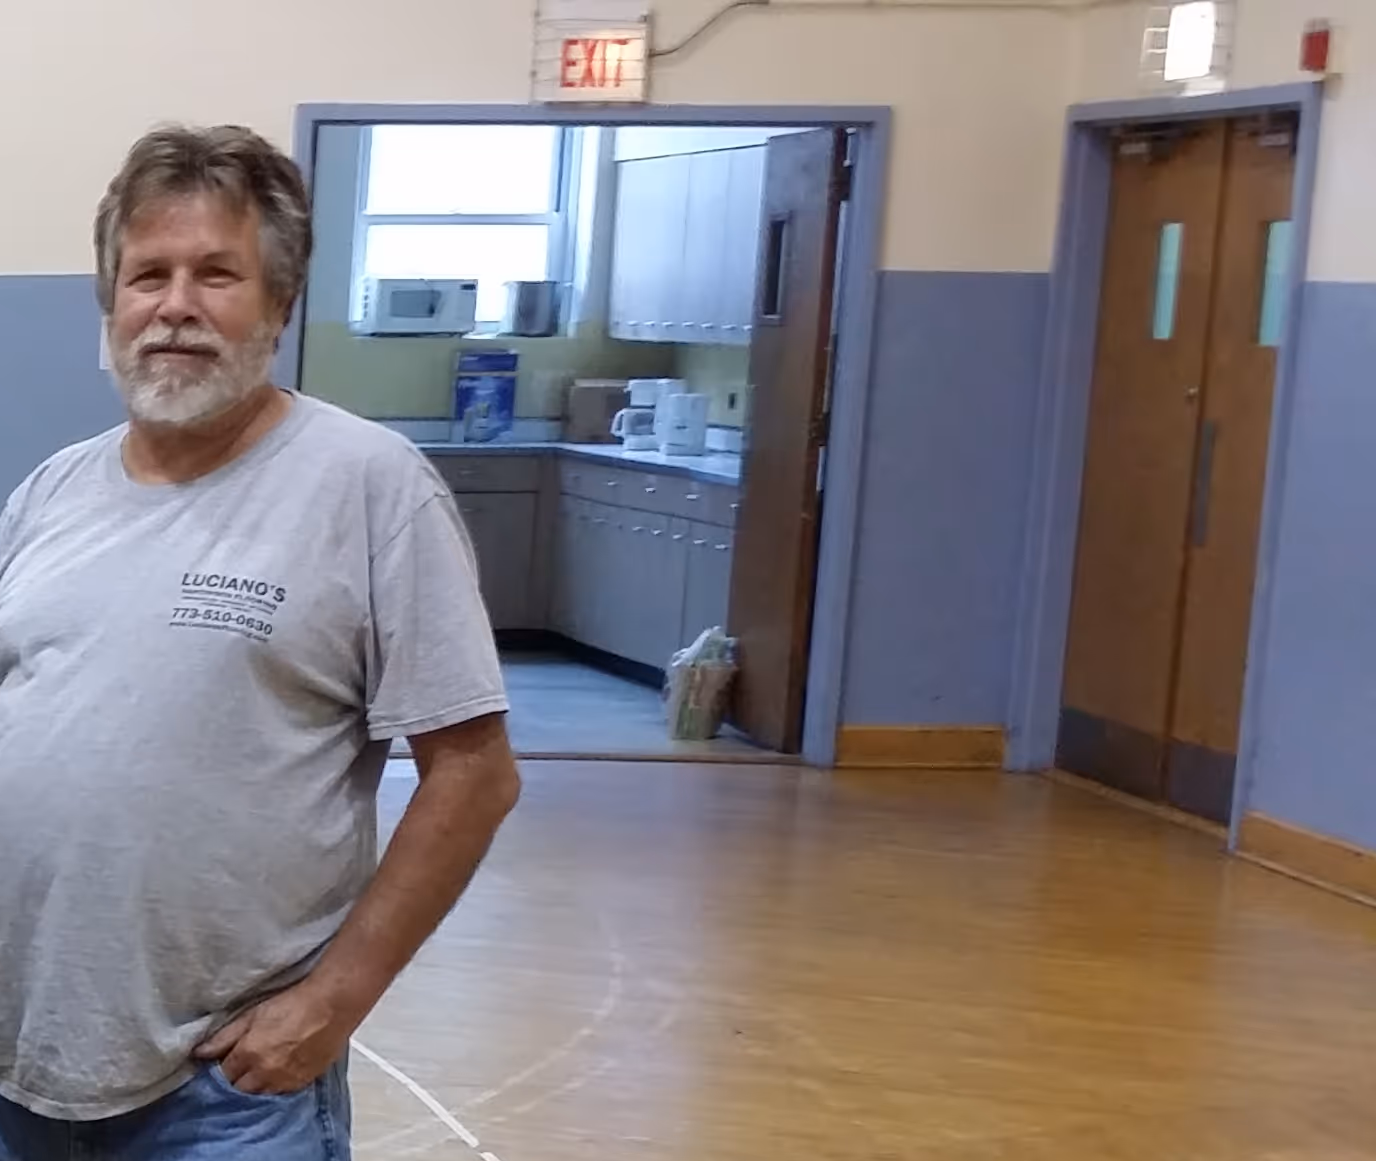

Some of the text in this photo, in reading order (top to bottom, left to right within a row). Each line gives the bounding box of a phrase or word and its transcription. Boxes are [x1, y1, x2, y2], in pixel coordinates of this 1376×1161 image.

[559, 38, 628, 88] EXIT
[181, 572, 286, 602] LUCIANO'S
[172, 607, 273, 635] 773-510-0630
